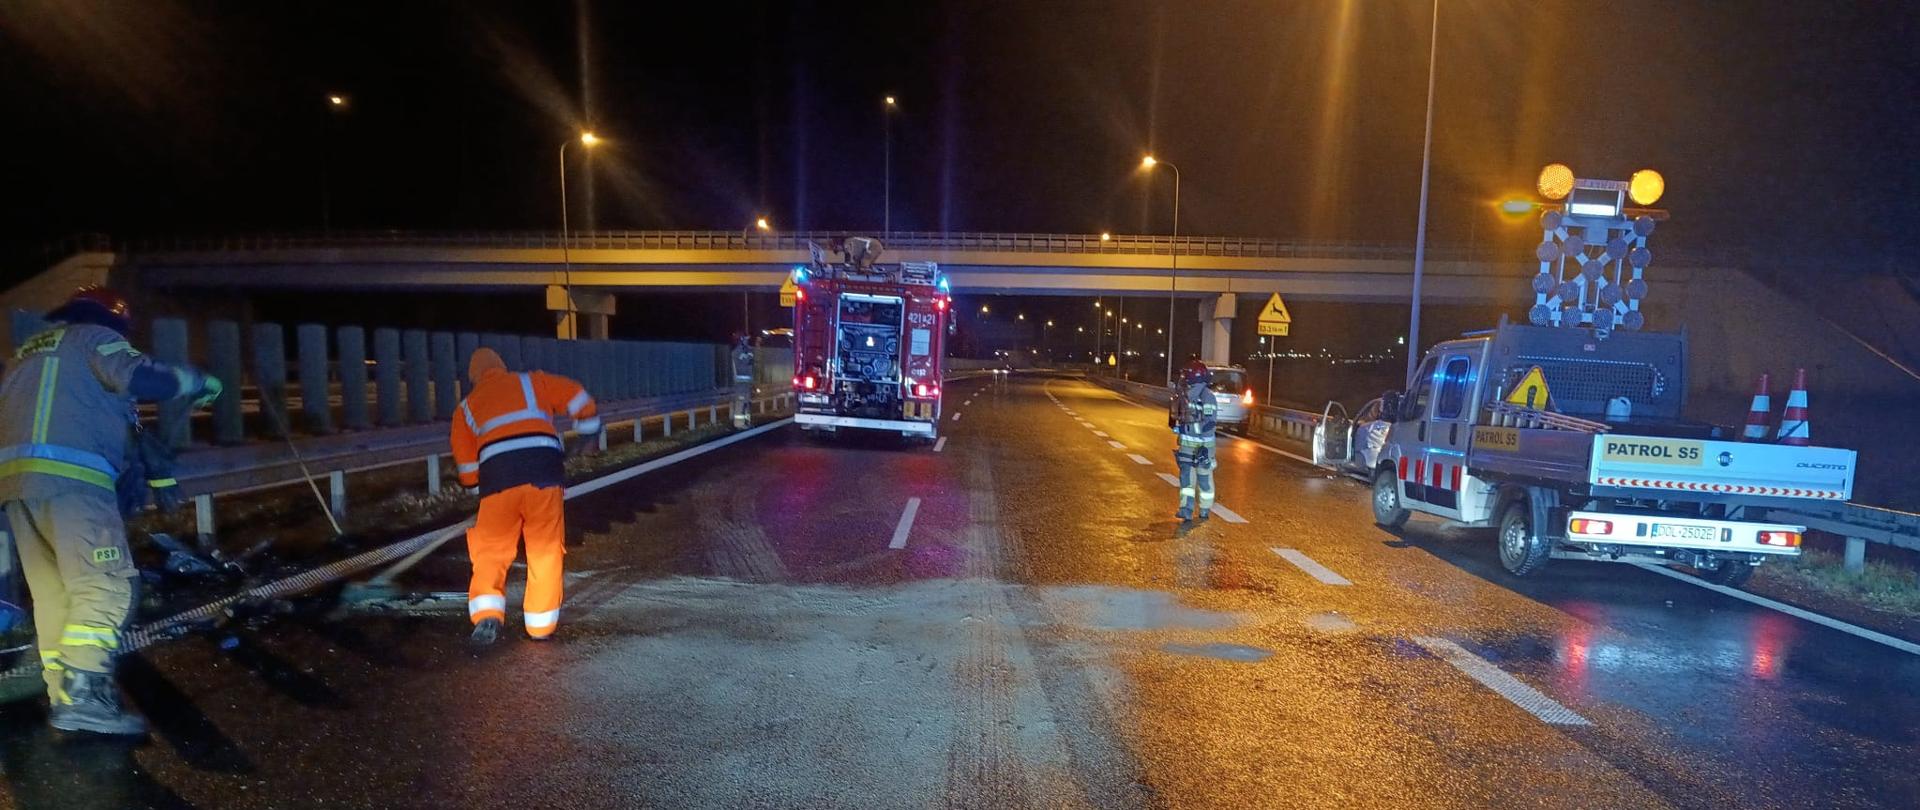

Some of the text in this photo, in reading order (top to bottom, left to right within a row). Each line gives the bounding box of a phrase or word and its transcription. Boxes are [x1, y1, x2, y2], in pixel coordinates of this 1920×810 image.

[1476, 430, 1517, 446] PATROL S5
[1607, 442, 1699, 460] PATROL S5
[1681, 527, 1713, 540] 2502E
[96, 549, 117, 560] PSP
